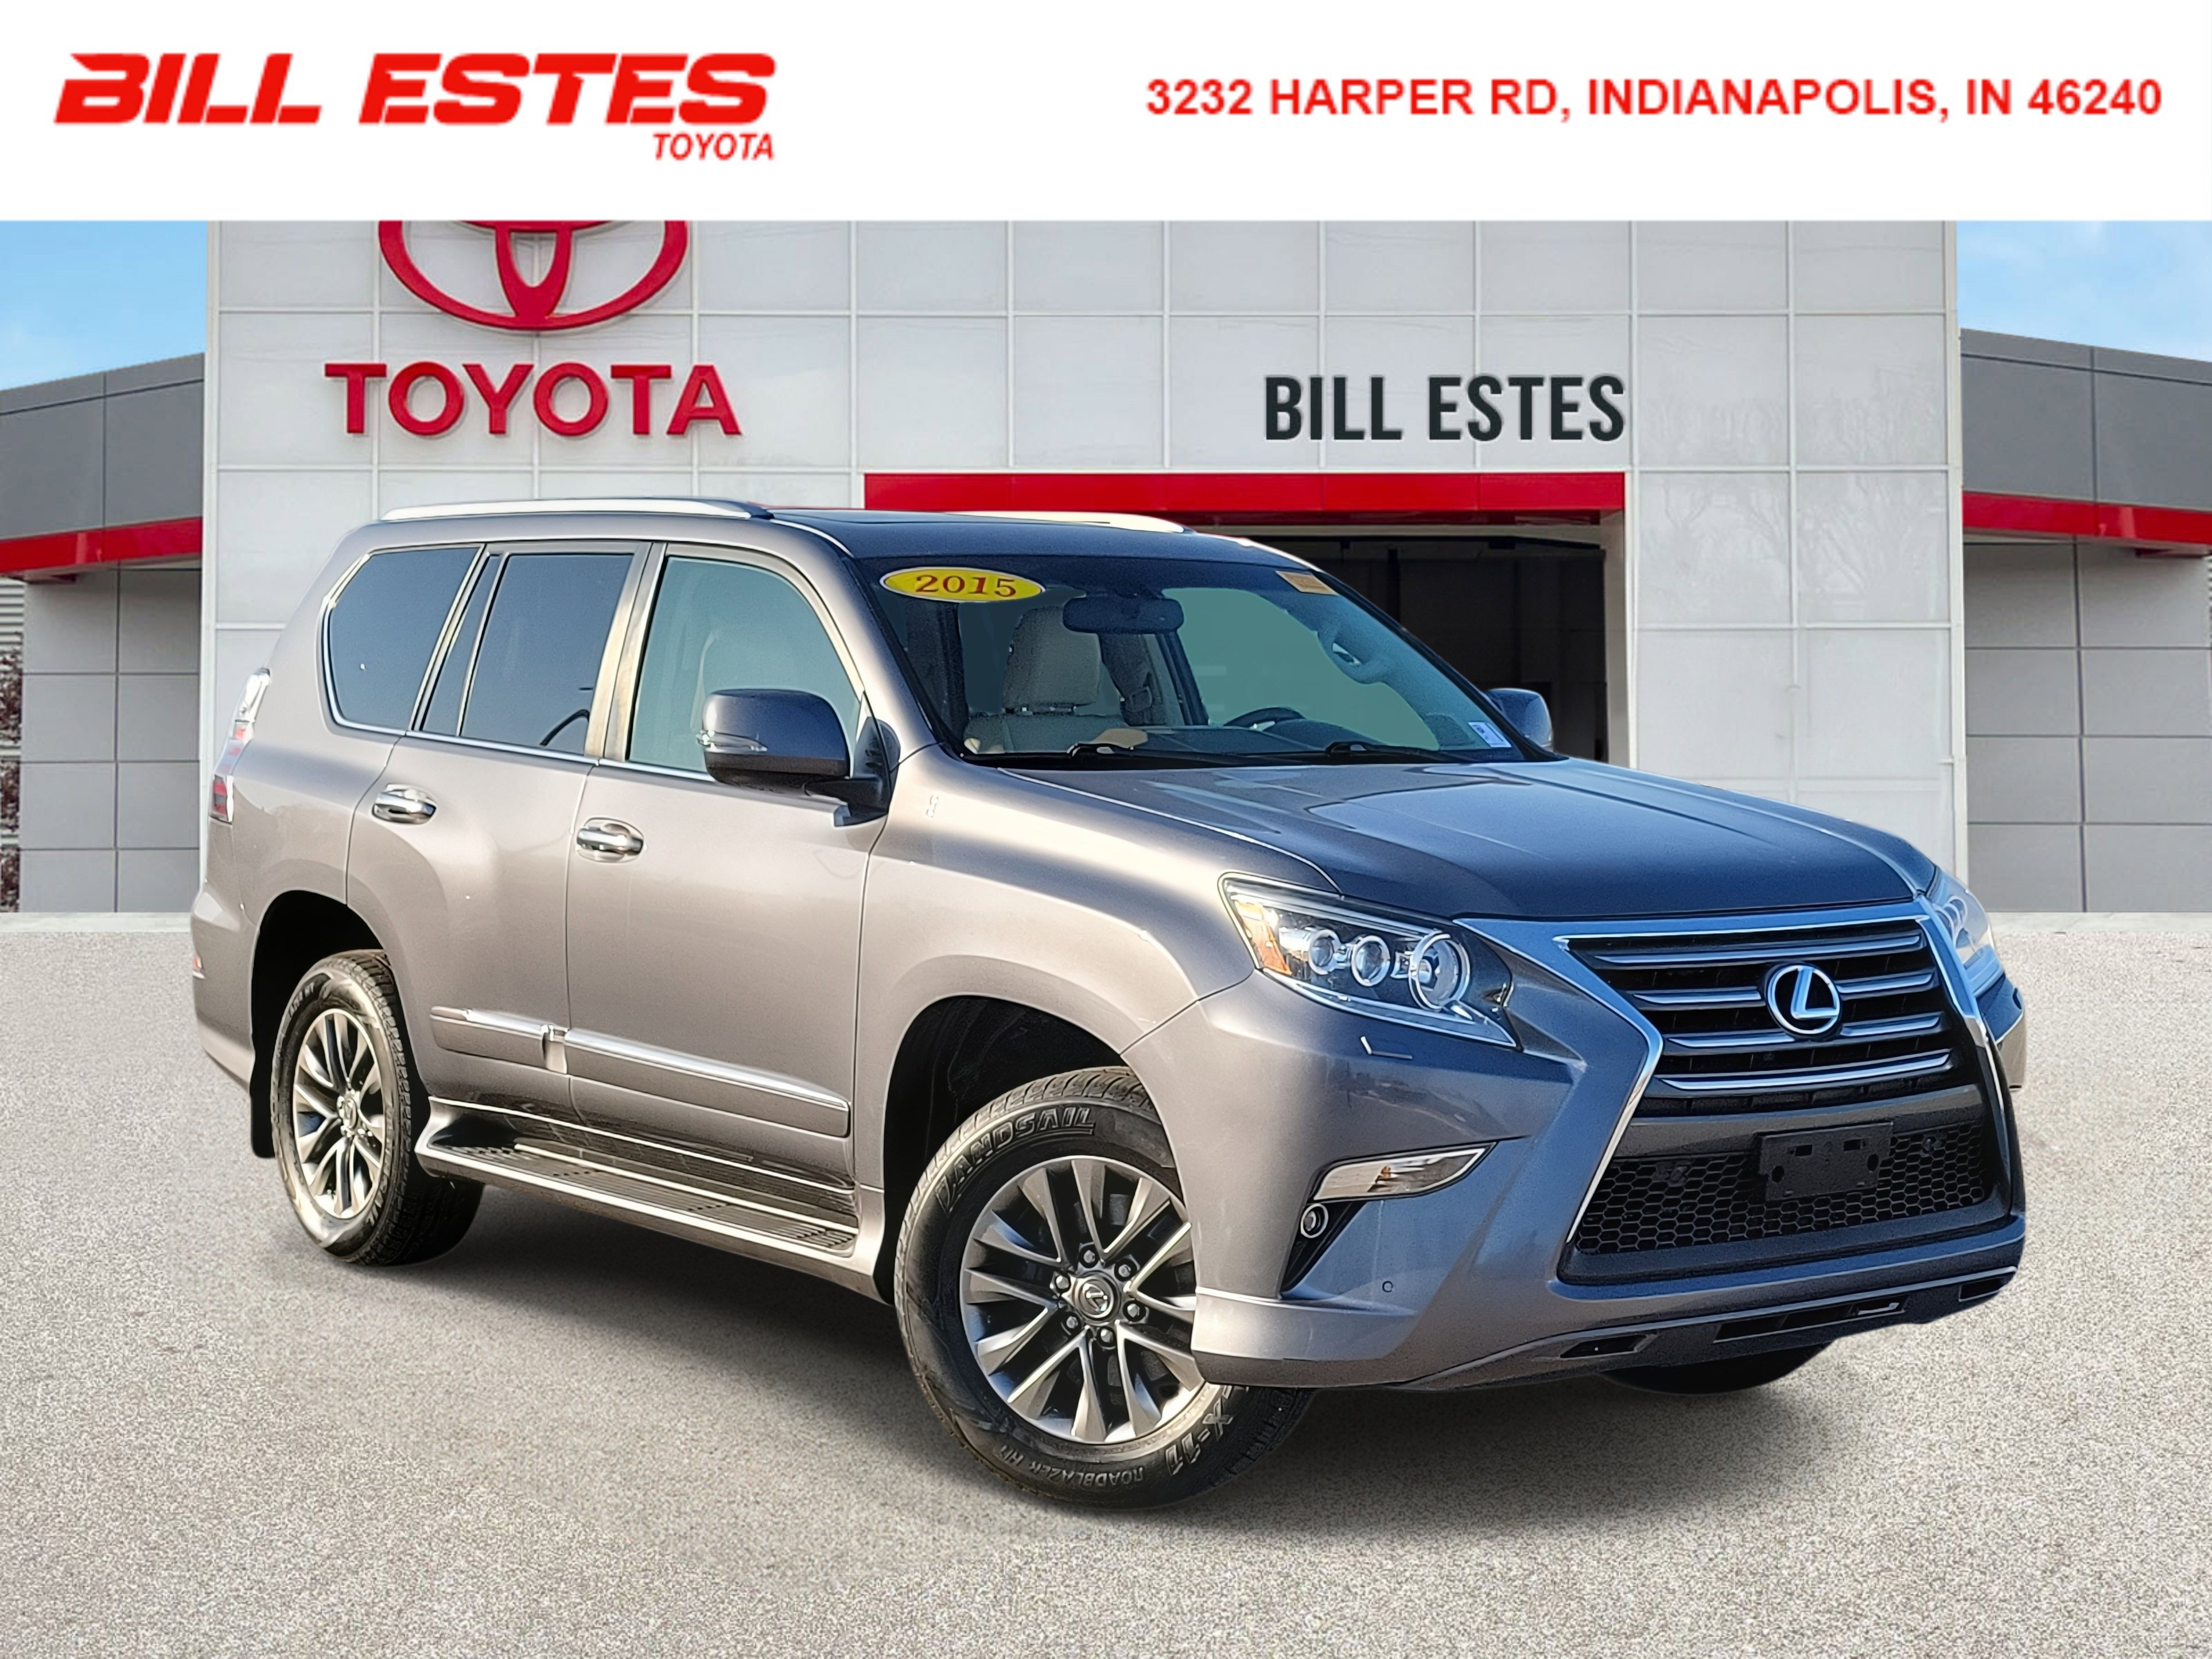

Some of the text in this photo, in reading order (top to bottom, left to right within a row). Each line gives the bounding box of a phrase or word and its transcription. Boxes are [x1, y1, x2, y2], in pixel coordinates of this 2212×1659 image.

[325, 361, 741, 436] TOYOTA
[1266, 375, 1624, 441] BILL ESTES
[915, 574, 1017, 597] 2015
[935, 1107, 1095, 1213] LANDSAIL
